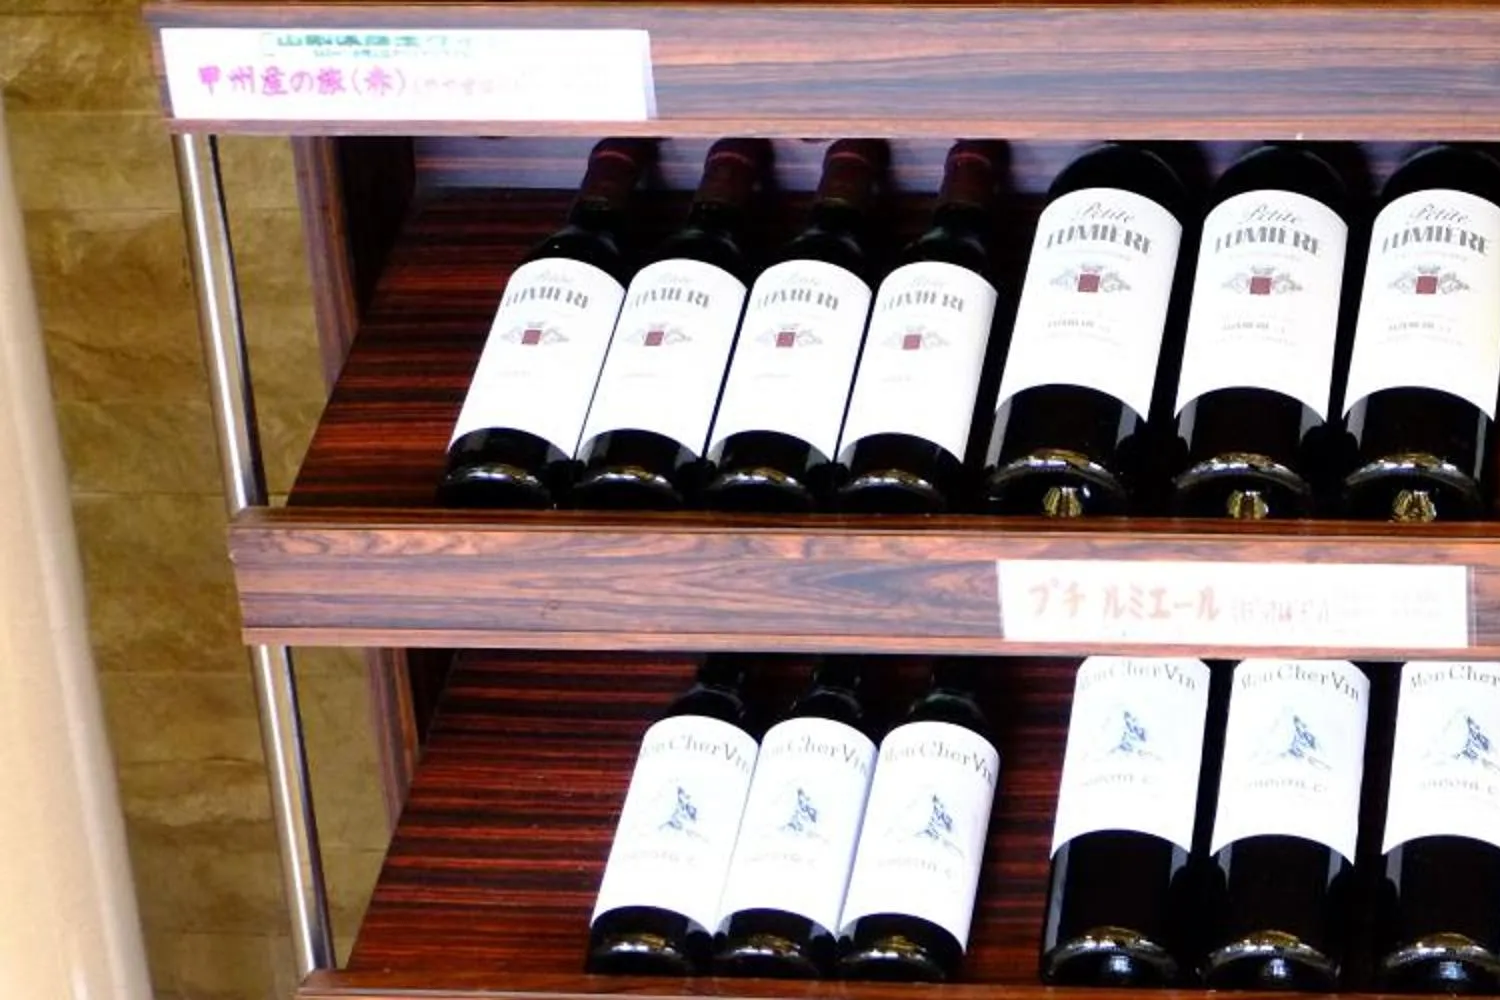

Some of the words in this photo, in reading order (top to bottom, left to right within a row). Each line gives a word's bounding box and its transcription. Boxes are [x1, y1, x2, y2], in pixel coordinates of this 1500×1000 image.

[1028, 576, 1087, 619] プチ
[1102, 582, 1220, 622] ルミエール
